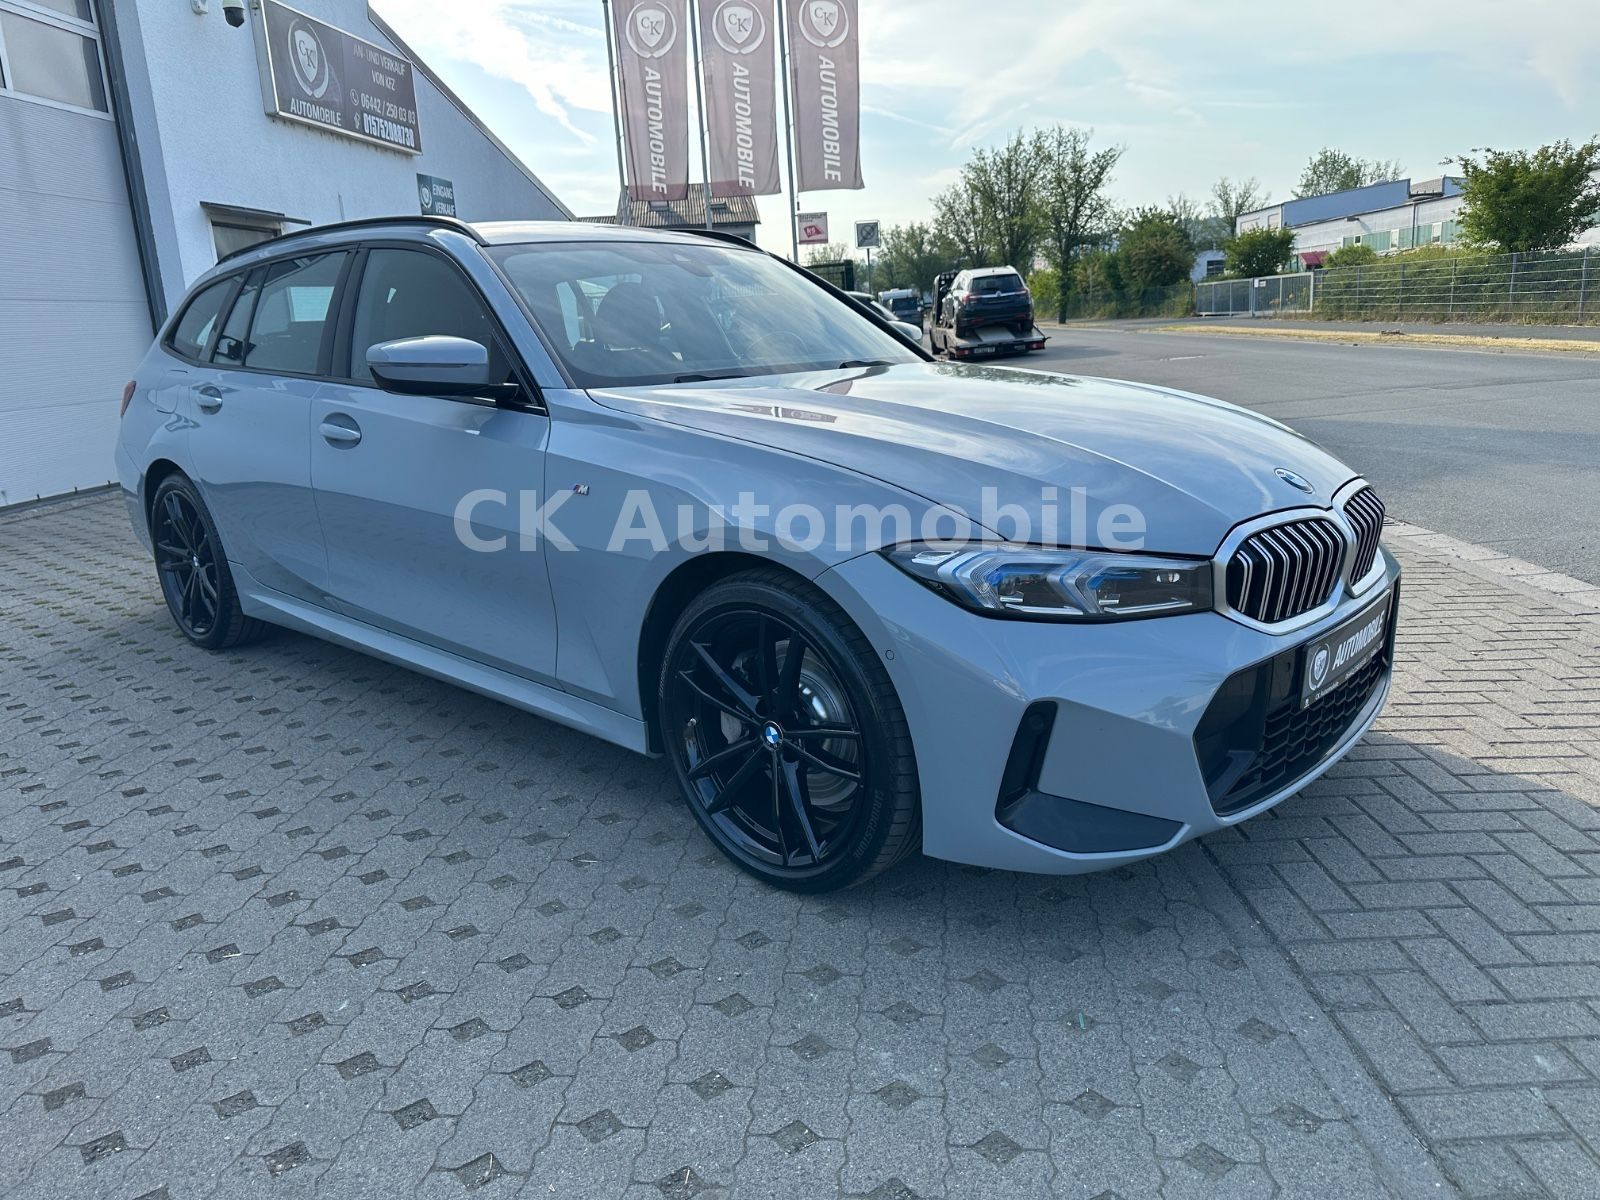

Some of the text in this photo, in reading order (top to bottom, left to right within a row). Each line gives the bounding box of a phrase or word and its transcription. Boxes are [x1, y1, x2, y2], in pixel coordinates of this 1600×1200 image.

[641, 16, 661, 36] CK
[728, 13, 748, 32] CK
[814, 6, 834, 26] CK
[379, 56, 405, 75] VERKAUF
[372, 70, 384, 86] VON
[290, 98, 341, 126] AUTOMOBILE
[361, 93, 381, 114] 06442
[732, 62, 755, 189] AUTOMOBILE
[818, 55, 841, 182] AUTOMOBILE
[644, 66, 667, 194] AUTOMOBILE
[1332, 609, 1385, 671] AUTOMOBILE
